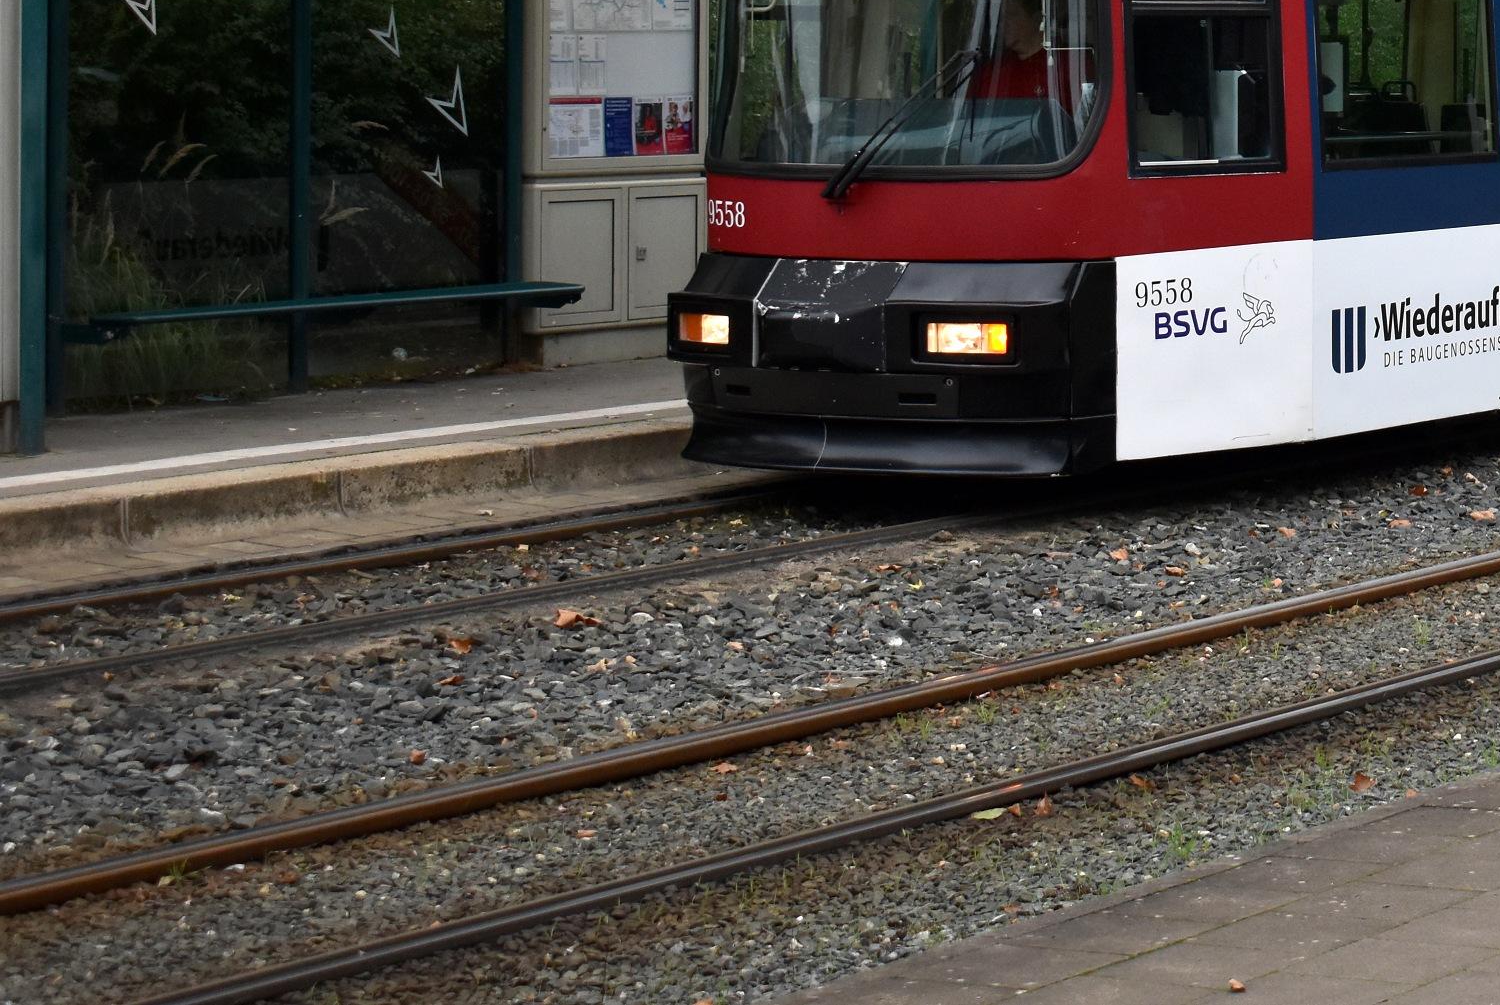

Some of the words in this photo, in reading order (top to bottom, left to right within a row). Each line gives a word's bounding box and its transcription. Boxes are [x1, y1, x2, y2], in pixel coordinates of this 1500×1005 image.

[708, 199, 746, 228] 9558
[1135, 277, 1193, 308] 9558
[1154, 306, 1228, 340] BSVG
[1383, 349, 1404, 368] DIE
